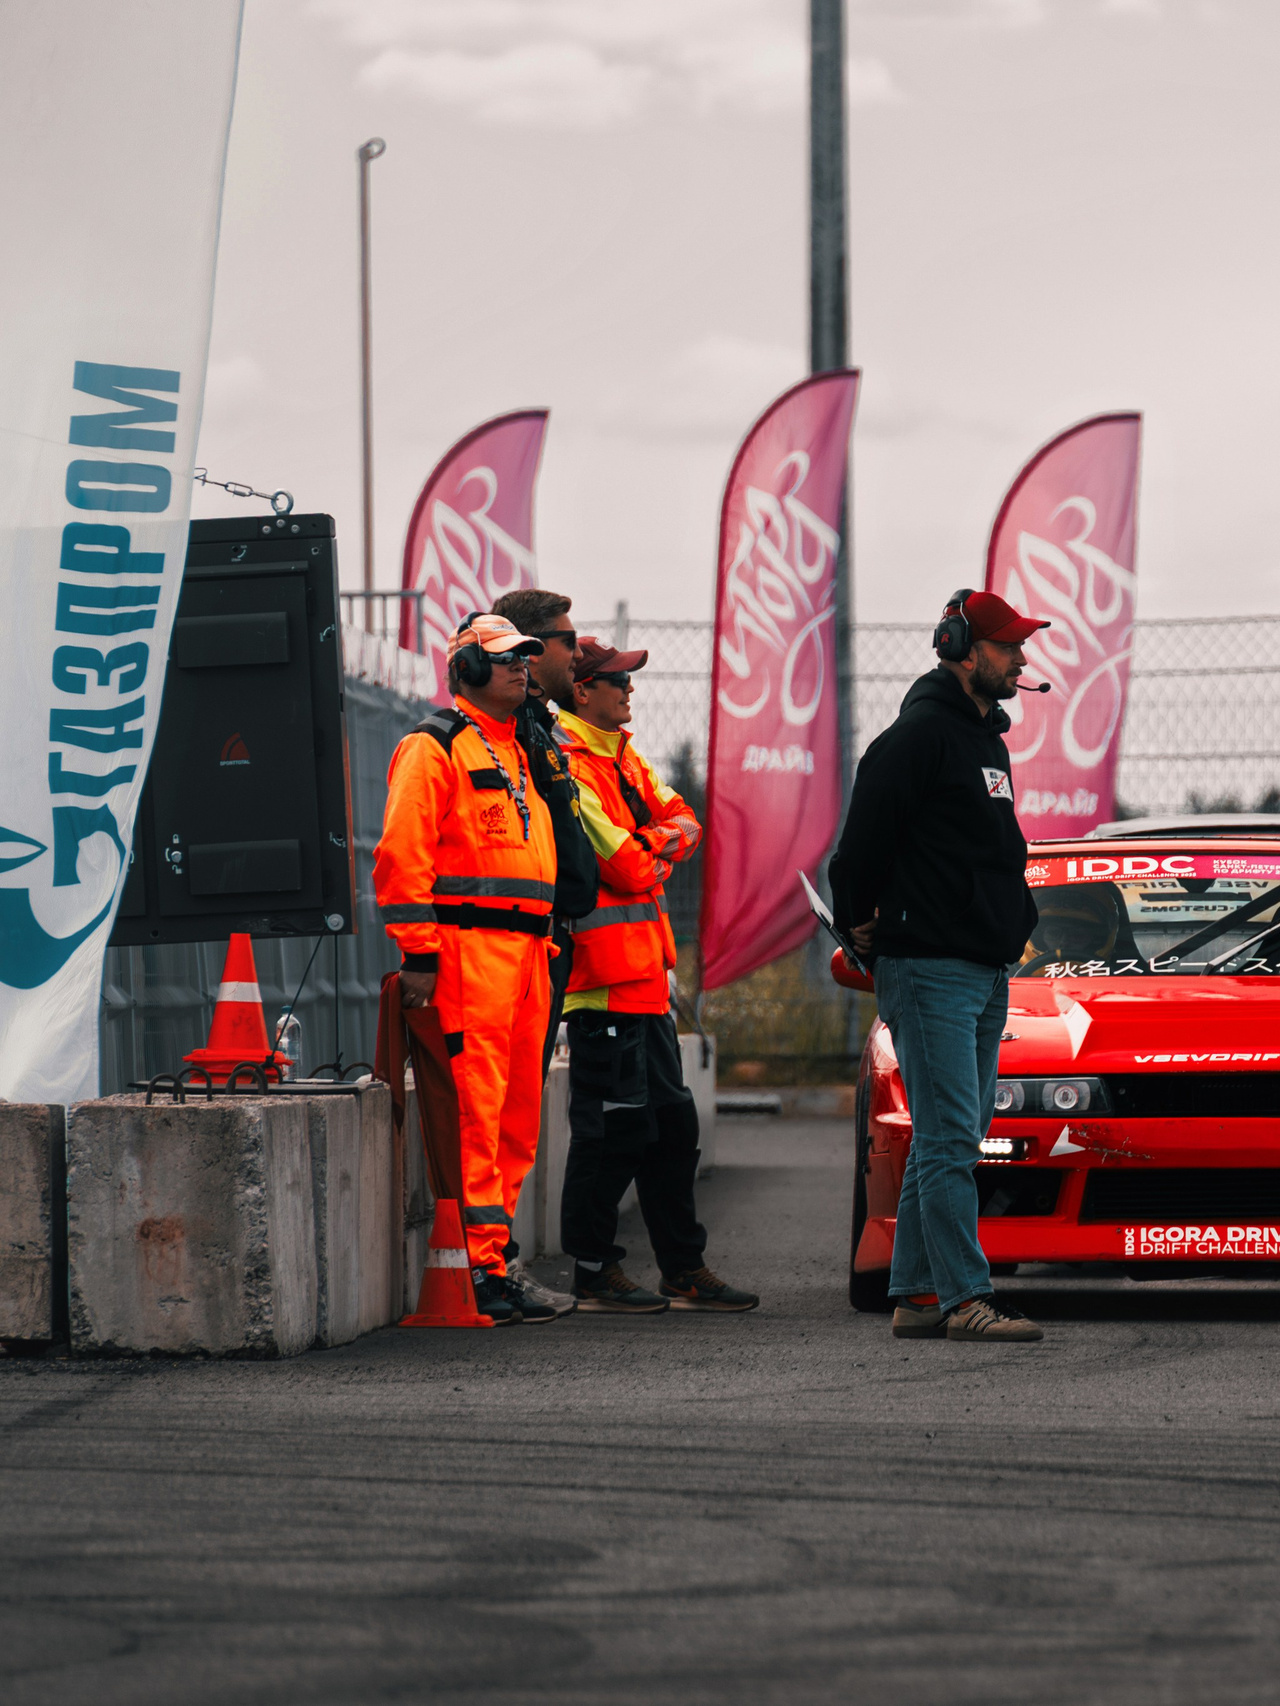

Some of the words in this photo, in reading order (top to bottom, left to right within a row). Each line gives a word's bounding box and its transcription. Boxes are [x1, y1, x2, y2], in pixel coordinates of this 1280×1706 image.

[48, 361, 180, 797] ГАЗПРОМ
[743, 745, 814, 774] ДРАЙВ
[1019, 788, 1099, 816] ДРАЙВ
[1067, 856, 1195, 877] IDDC
[1125, 1228, 1135, 1256] IDDC
[1140, 1227, 1220, 1242] IGORA
[1140, 1243, 1192, 1255] DRIFT
